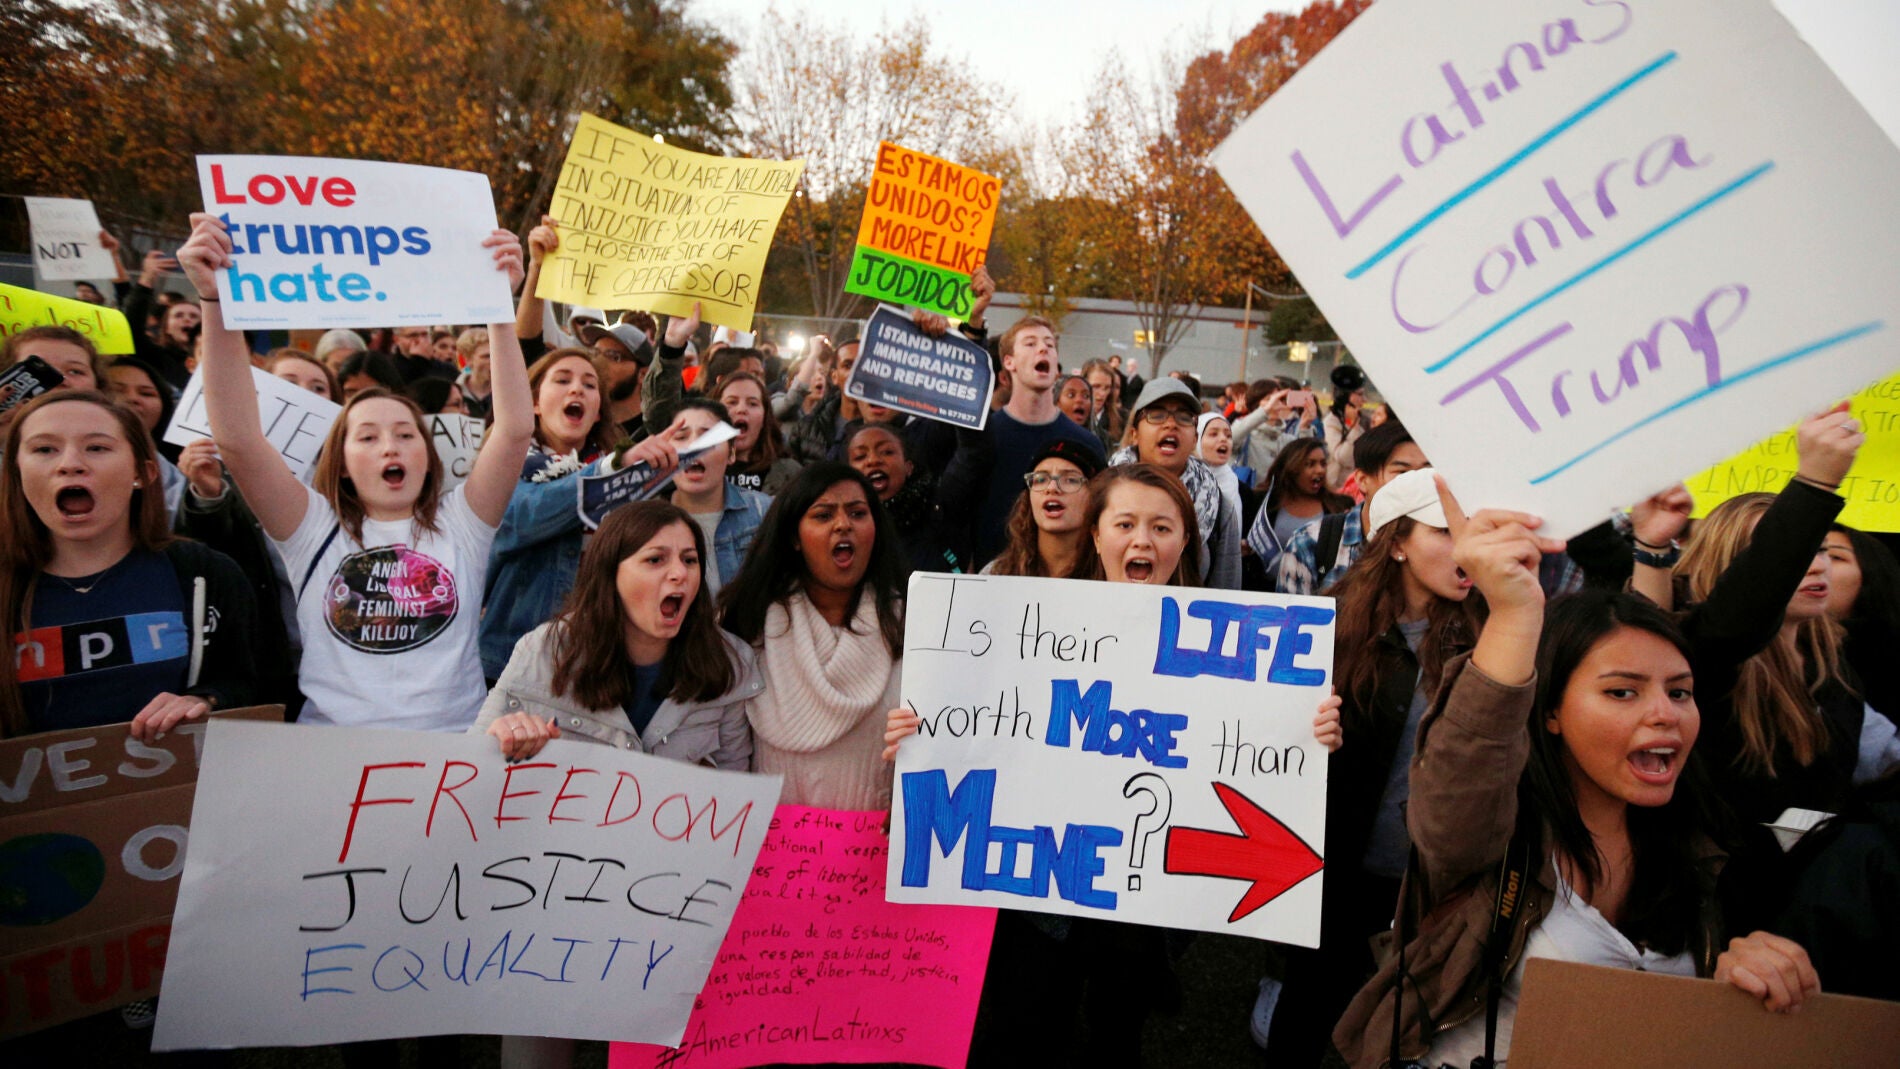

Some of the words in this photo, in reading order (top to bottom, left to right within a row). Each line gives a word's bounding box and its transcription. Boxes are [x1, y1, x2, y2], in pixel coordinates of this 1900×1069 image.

[1290, 0, 1632, 239] Latinas
[577, 127, 635, 164] IF
[641, 147, 691, 180] YOU
[687, 166, 728, 189] ARE
[726, 167, 796, 193] NEUTRAL
[878, 145, 997, 210] ESTAMOS
[211, 164, 357, 208] Love
[559, 162, 594, 193] IN
[595, 170, 702, 219] SITUATIONS
[705, 195, 739, 216] OF
[871, 179, 983, 237] UNIDOS?
[38, 242, 88, 259] NOT
[219, 213, 431, 265] trumps
[566, 232, 648, 261] CHOSEN
[675, 242, 709, 261] SIDE
[713, 243, 744, 261] OF
[672, 218, 712, 241] YOU
[710, 218, 769, 243] HAVE
[1391, 134, 1713, 333] Contra
[227, 261, 387, 303] hate.
[555, 256, 607, 295] THE
[613, 263, 753, 305] OPPRESSOR.
[856, 254, 972, 316] JODIDOS
[873, 342, 974, 382] IMMIGRANTS
[878, 323, 884, 337] I
[884, 325, 932, 351] STAND
[935, 341, 976, 365] WITH
[1440, 284, 1749, 433] Trump
[862, 358, 892, 379] AND
[893, 368, 977, 401] REFUGEES
[738, 474, 761, 487] are
[357, 600, 427, 618] FEMINIST
[910, 576, 992, 657] Is
[1017, 603, 1118, 663] their
[1153, 596, 1335, 686] LIFE
[16, 622, 169, 669] npr
[360, 624, 418, 642] KILLJOY
[908, 687, 1033, 740] worth
[1045, 679, 1188, 768] MORE
[1211, 720, 1305, 777] than
[337, 760, 754, 863] FREEDOM
[794, 812, 812, 828] of
[813, 813, 843, 831] the
[299, 852, 733, 933] JUSTICE
[787, 859, 810, 880] of
[1501, 870, 1520, 919] Nikon
[720, 953, 747, 965] una
[903, 946, 922, 962] de
[742, 924, 791, 945] pueblo
[805, 922, 820, 939] de
[827, 924, 844, 940] los
[851, 925, 899, 941] Estados
[301, 930, 675, 1003] EQUALITY
[737, 967, 780, 981] valores
[790, 964, 808, 979] de
[902, 963, 960, 985] justicia
[719, 984, 800, 1006] igualdad.
[655, 1005, 908, 1069] #AmericanLatinxs
